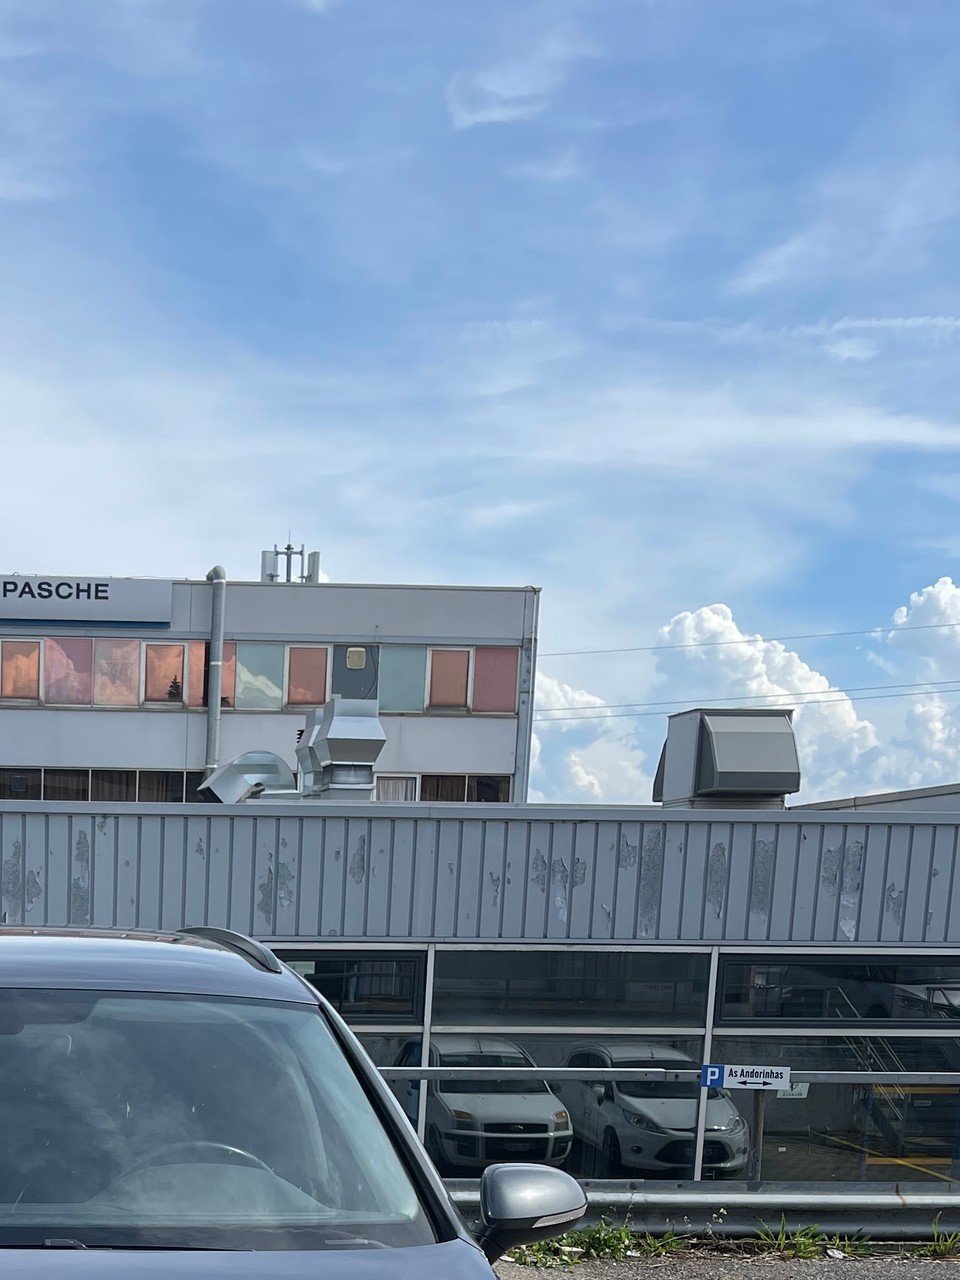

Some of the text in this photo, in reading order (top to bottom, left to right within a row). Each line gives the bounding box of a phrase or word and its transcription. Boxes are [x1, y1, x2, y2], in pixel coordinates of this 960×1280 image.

[2, 581, 109, 600] PASCHE
[706, 1067, 784, 1086] P As Andorinhas
